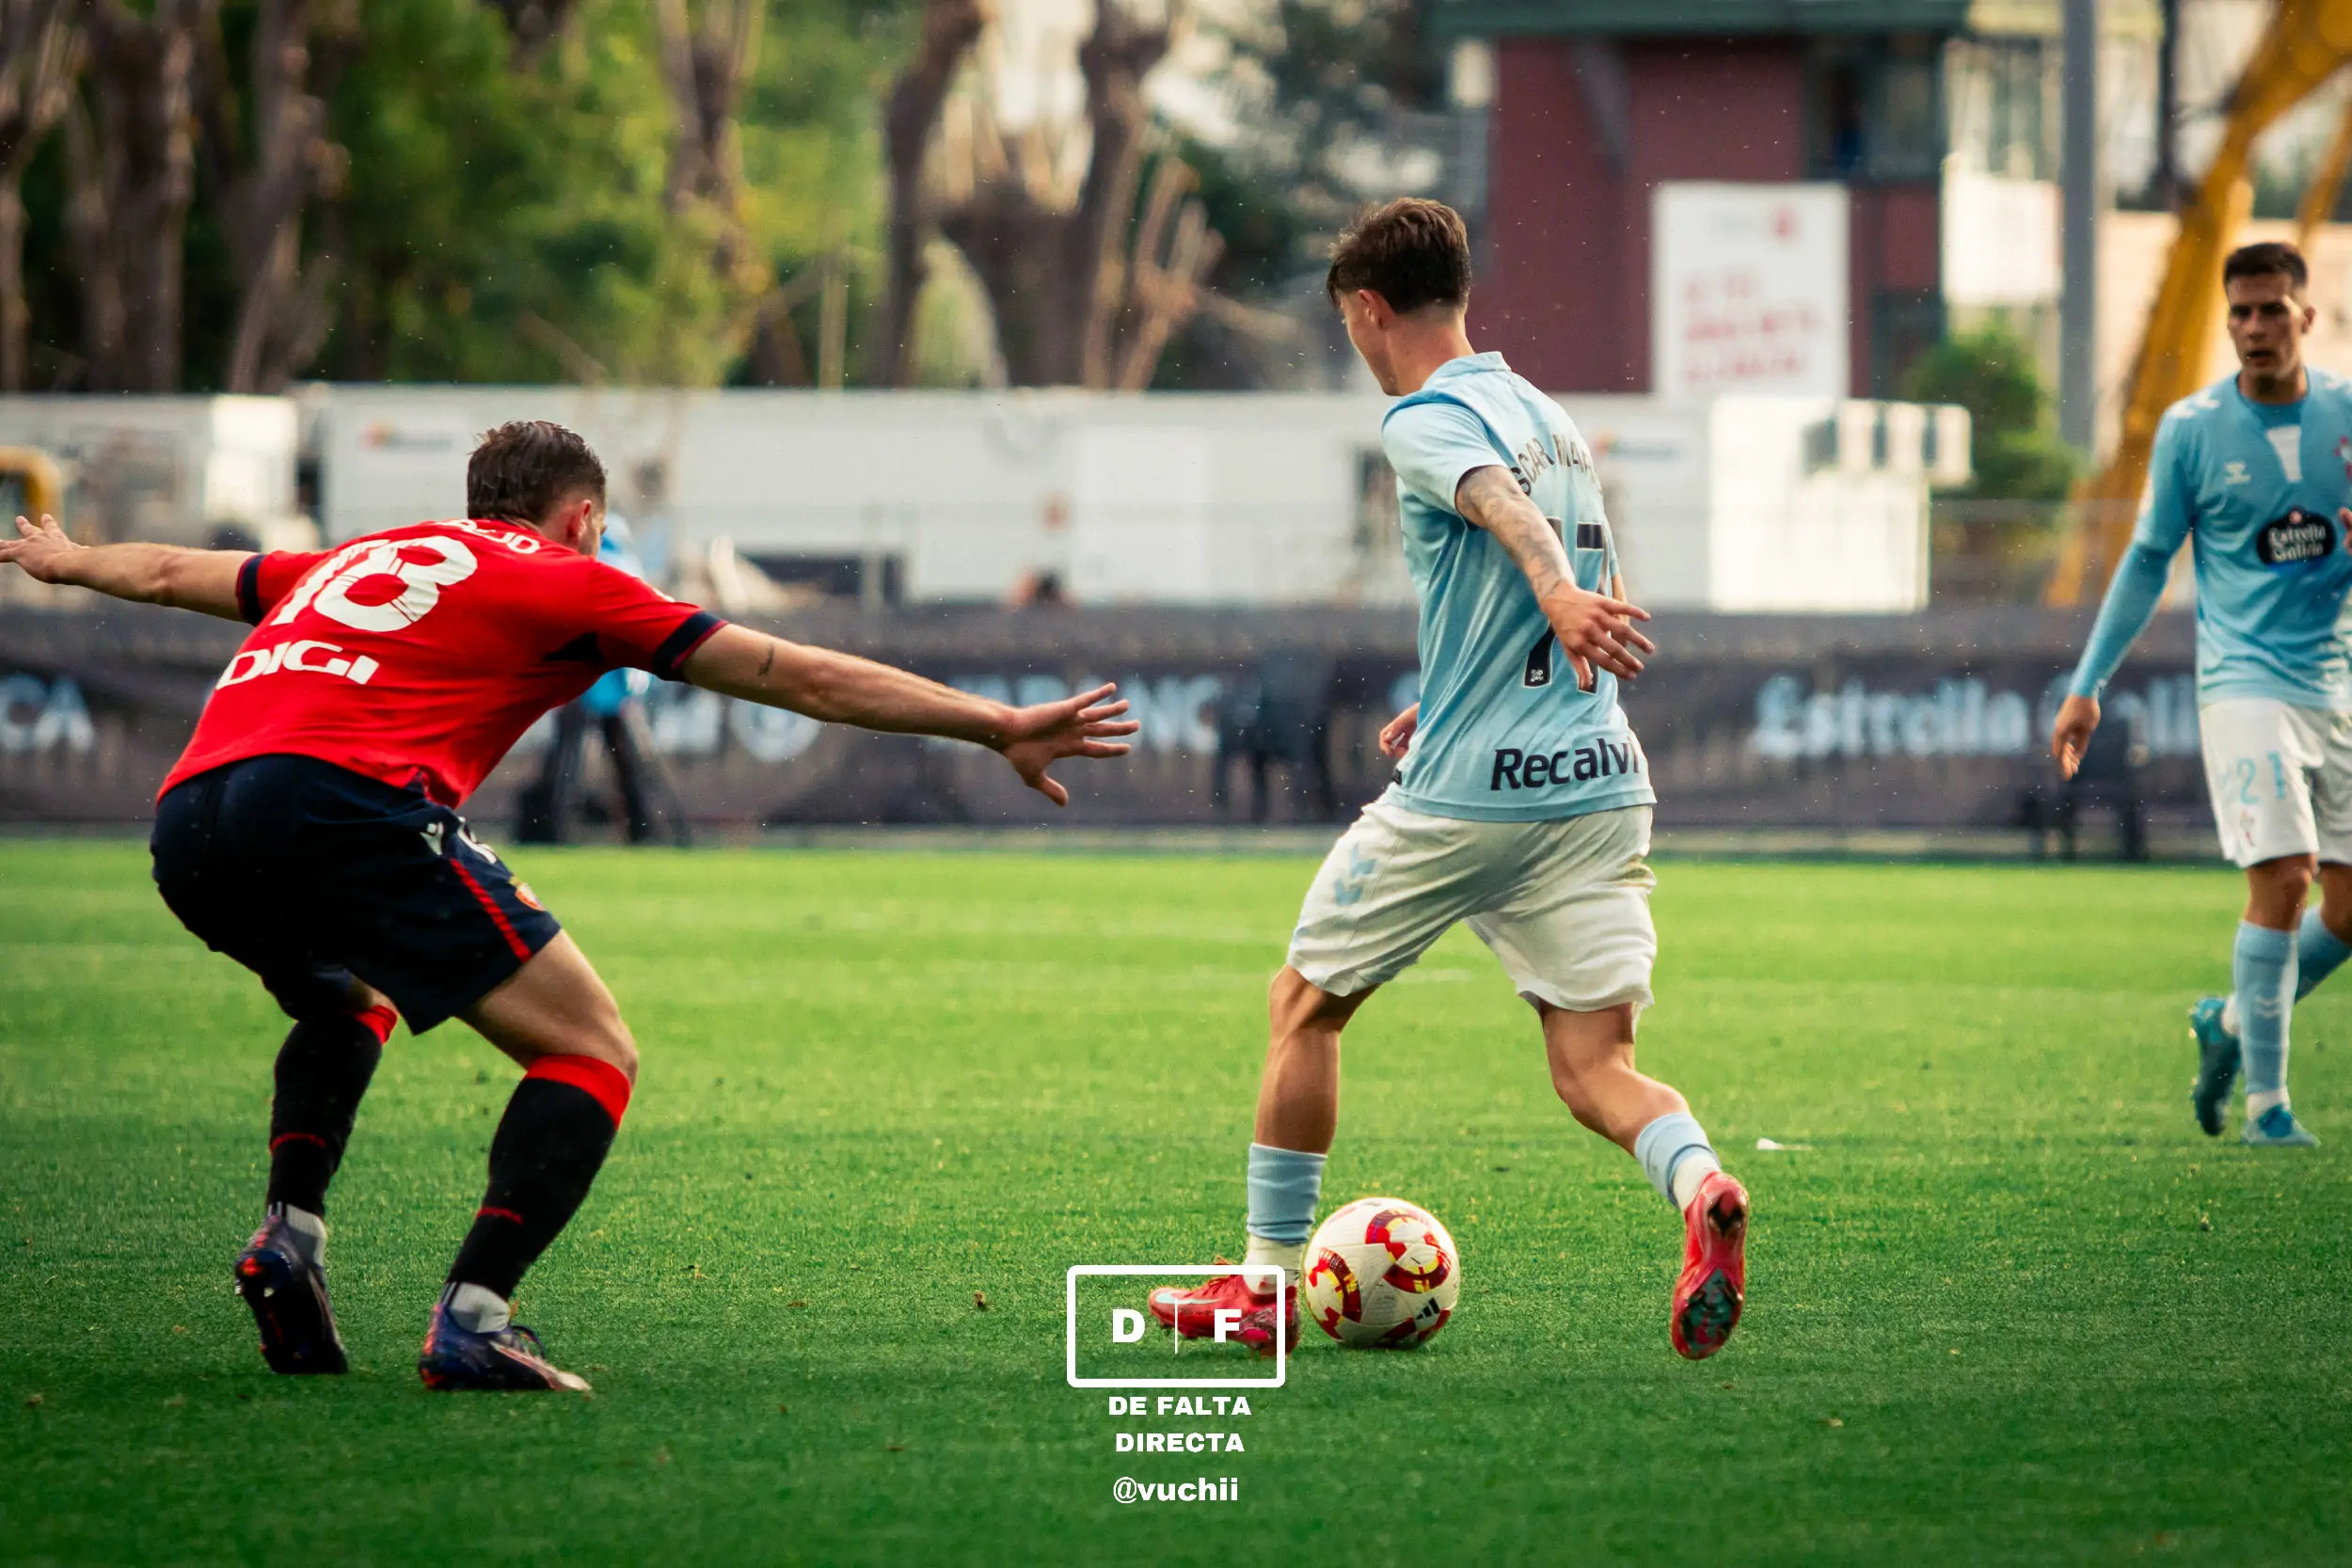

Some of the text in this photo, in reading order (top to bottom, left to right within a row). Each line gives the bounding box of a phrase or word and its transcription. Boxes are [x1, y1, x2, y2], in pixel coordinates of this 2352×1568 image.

[270, 535, 478, 632] 18
[215, 640, 380, 690] DIGI
[2236, 751, 2287, 804] 21
